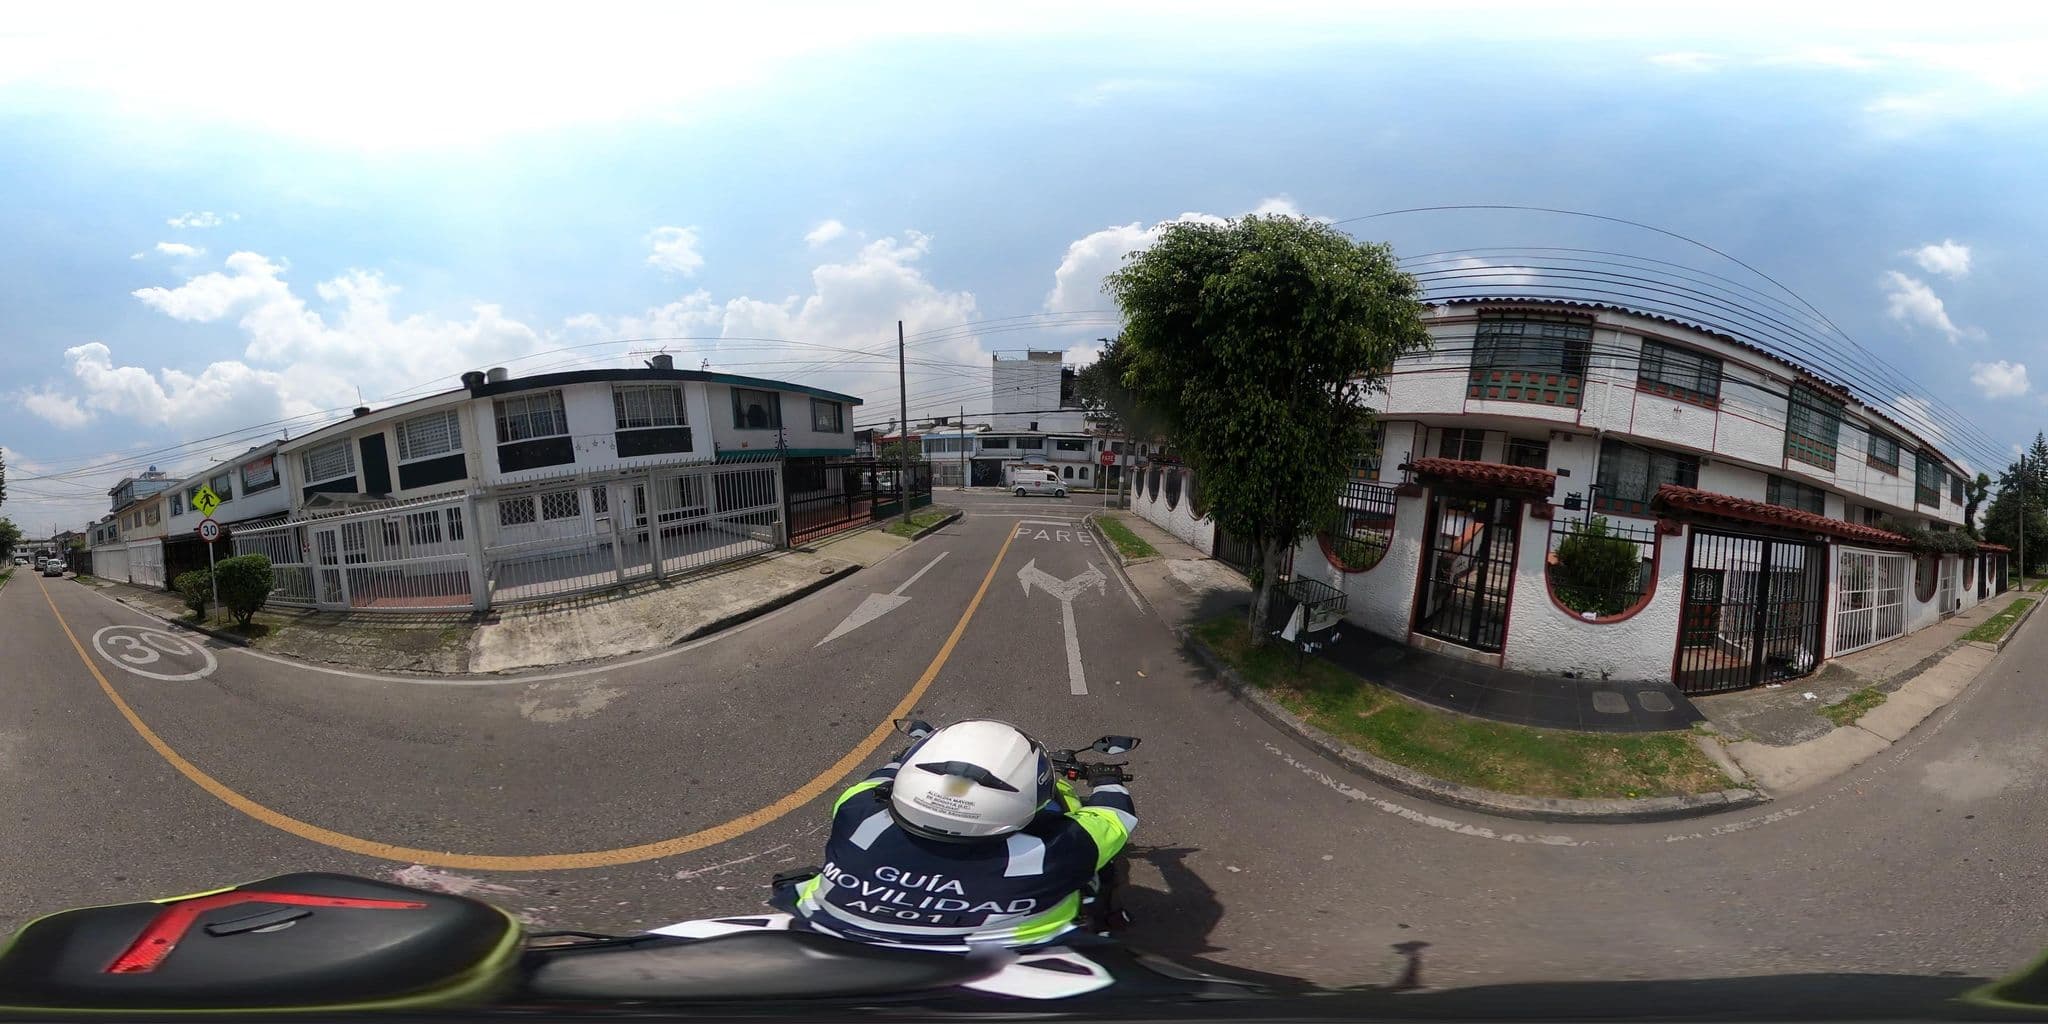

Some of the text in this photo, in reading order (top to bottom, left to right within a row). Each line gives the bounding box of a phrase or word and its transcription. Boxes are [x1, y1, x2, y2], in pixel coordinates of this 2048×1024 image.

[203, 525, 217, 536] 30
[1014, 528, 1092, 543] PARE
[107, 632, 193, 664] 30
[822, 862, 1037, 913] MOVILIDAD
[875, 866, 965, 896] GUÍA
[845, 900, 943, 923] AF01
